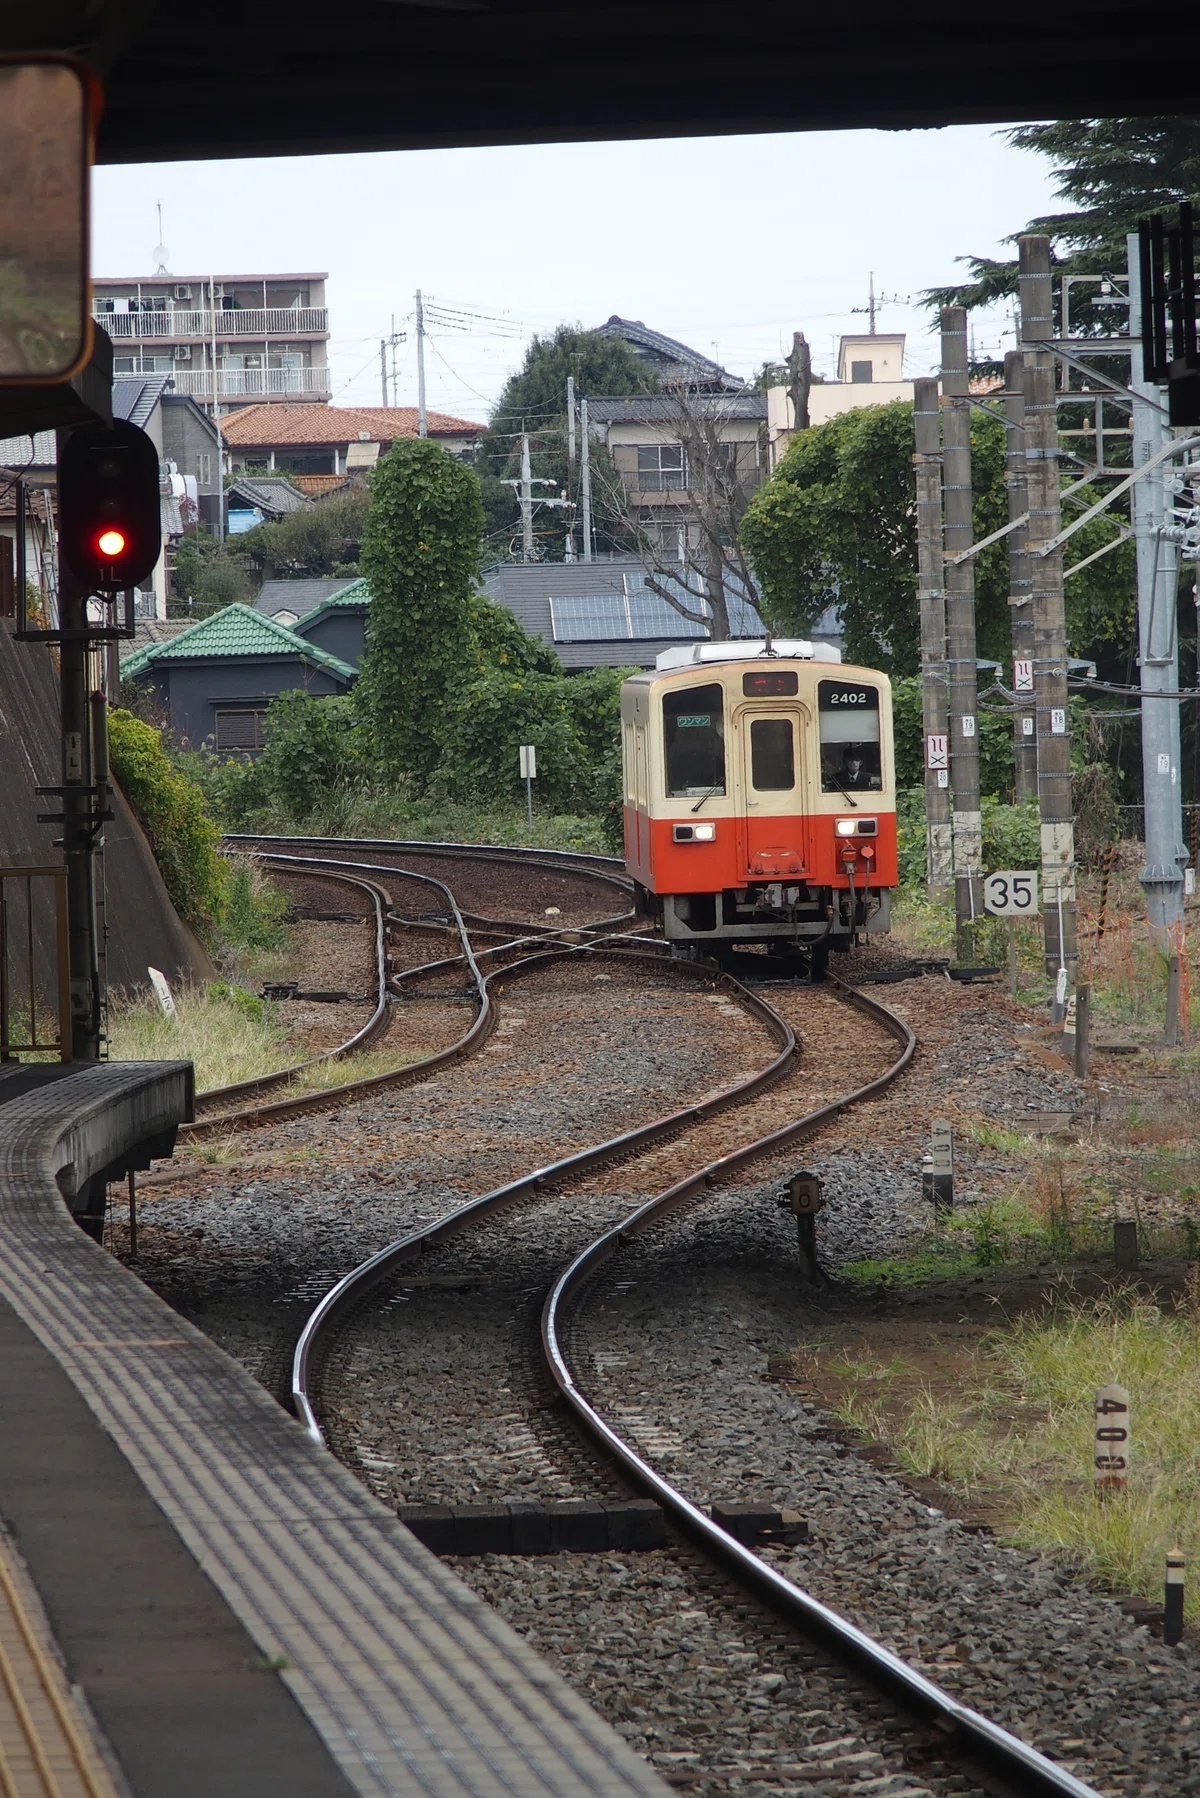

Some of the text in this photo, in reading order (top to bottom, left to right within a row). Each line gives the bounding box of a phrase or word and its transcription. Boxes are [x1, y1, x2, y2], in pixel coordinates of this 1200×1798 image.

[830, 692, 867, 704] 2402
[678, 717, 709, 726] ワンマン
[1054, 715, 1064, 724] 18
[990, 877, 1032, 909] 35
[1095, 1399, 1128, 1470] 400
